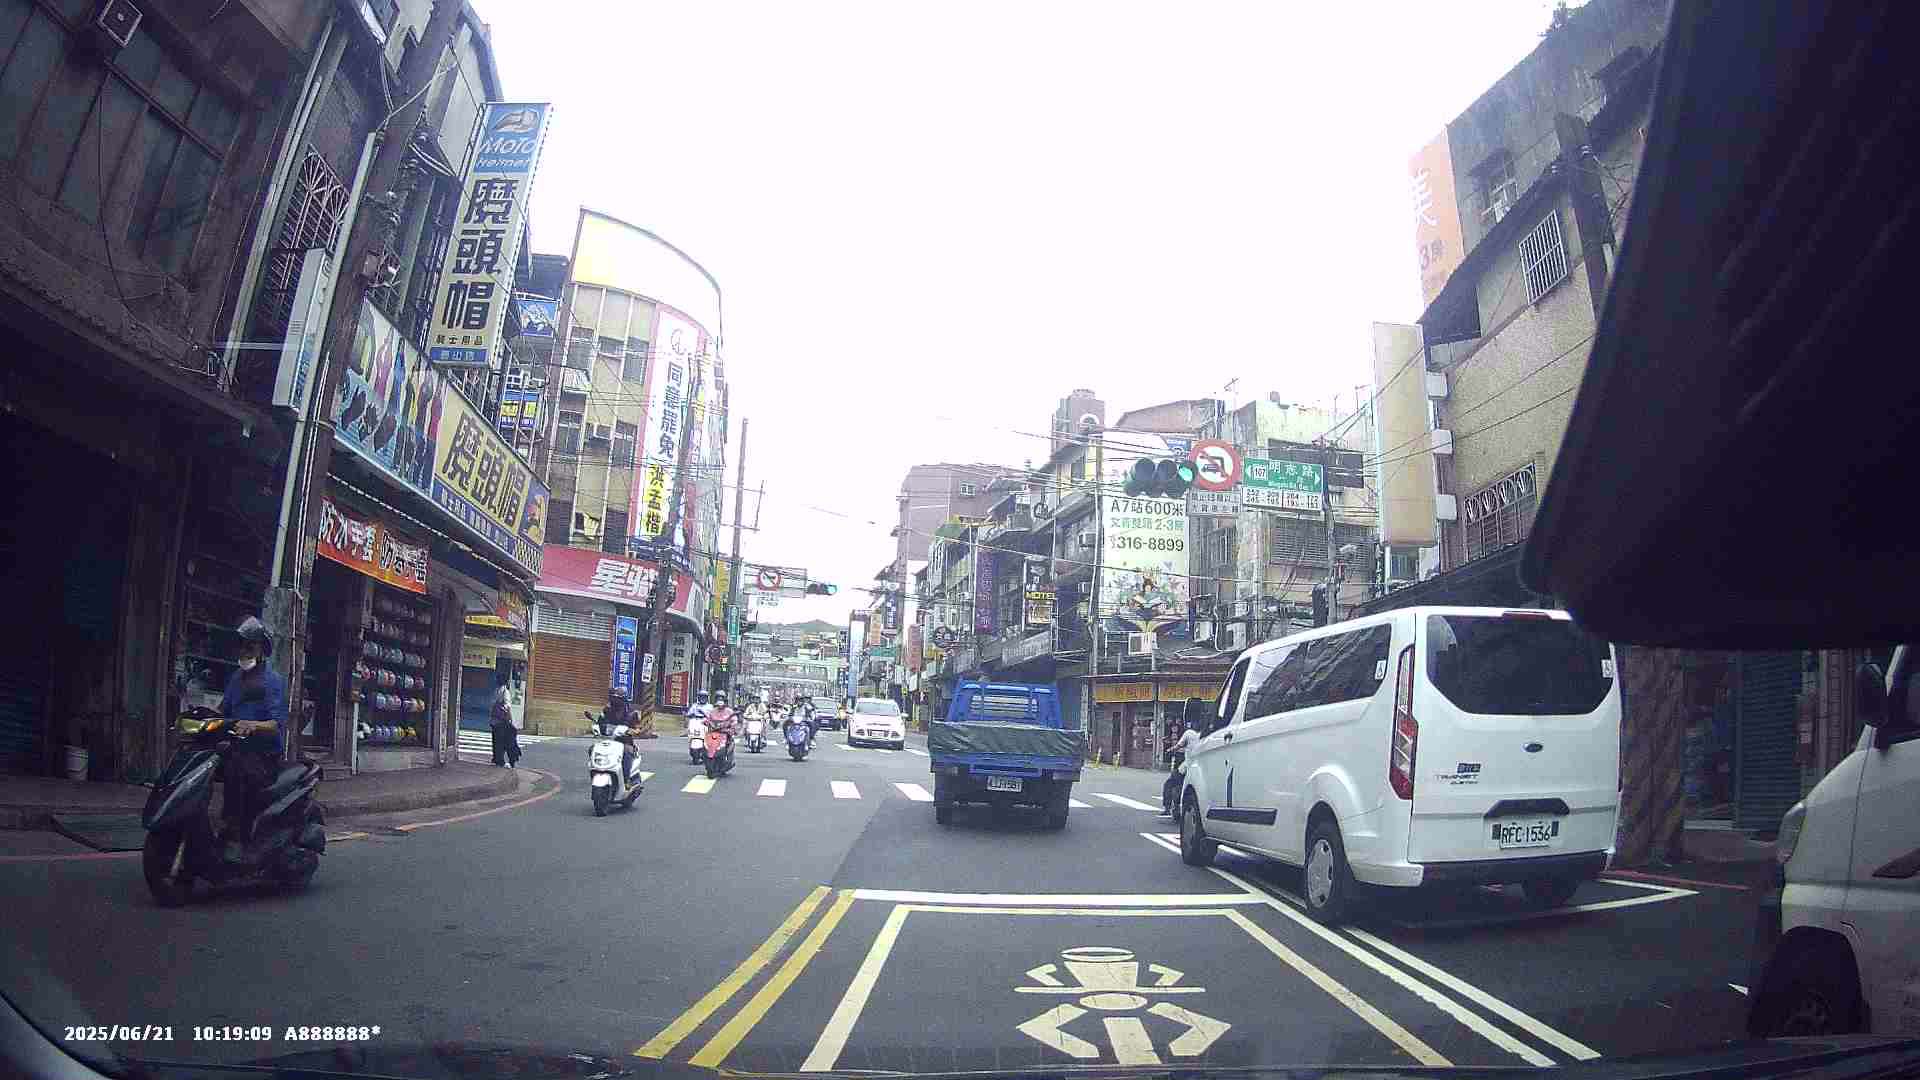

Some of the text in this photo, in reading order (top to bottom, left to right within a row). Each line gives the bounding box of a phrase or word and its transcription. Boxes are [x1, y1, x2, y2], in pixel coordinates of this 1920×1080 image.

[441, 178, 520, 329] 魔頭帽
[442, 410, 527, 528] 魔頭帽
[1268, 460, 1313, 477] 明志路
[1111, 498, 1184, 517] A7站600米
[1025, 591, 1057, 600] MOTEL
